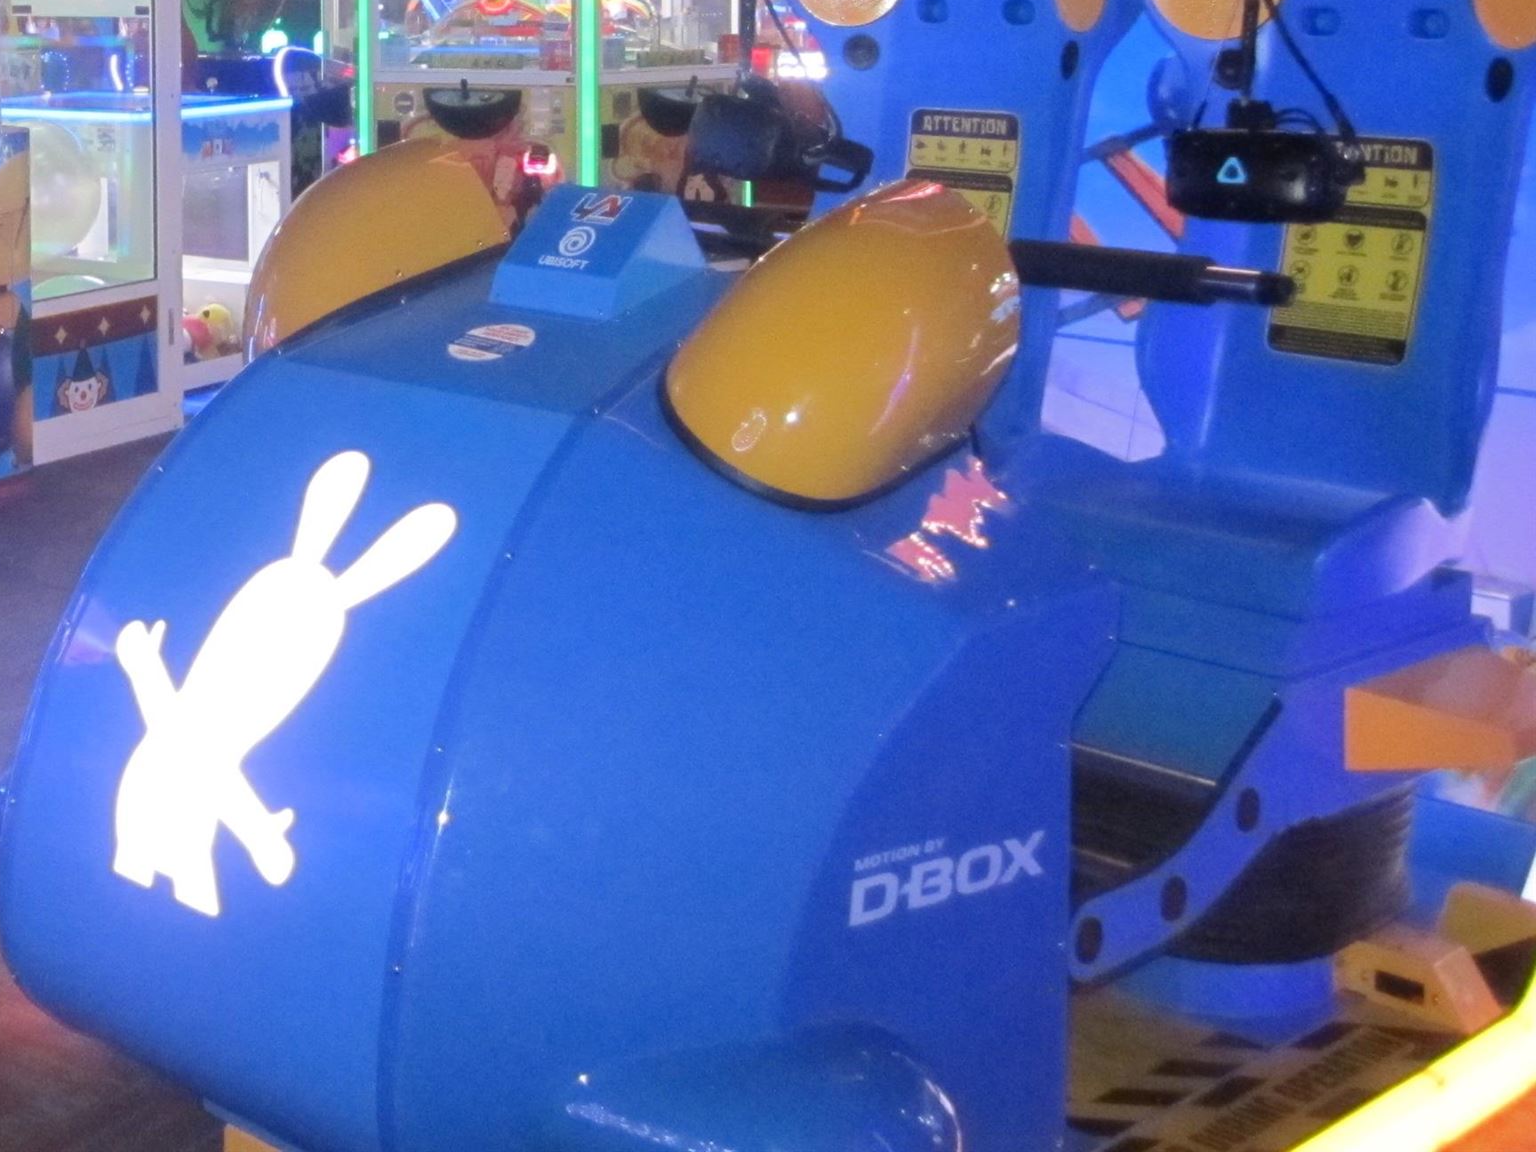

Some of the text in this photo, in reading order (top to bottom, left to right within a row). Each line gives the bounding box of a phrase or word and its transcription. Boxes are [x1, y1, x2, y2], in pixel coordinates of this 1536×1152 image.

[923, 115, 1009, 135] ATTENTION
[538, 255, 590, 270] UBISOFT
[854, 837, 945, 872] MOTION BY
[848, 830, 1046, 928] D-BOX
